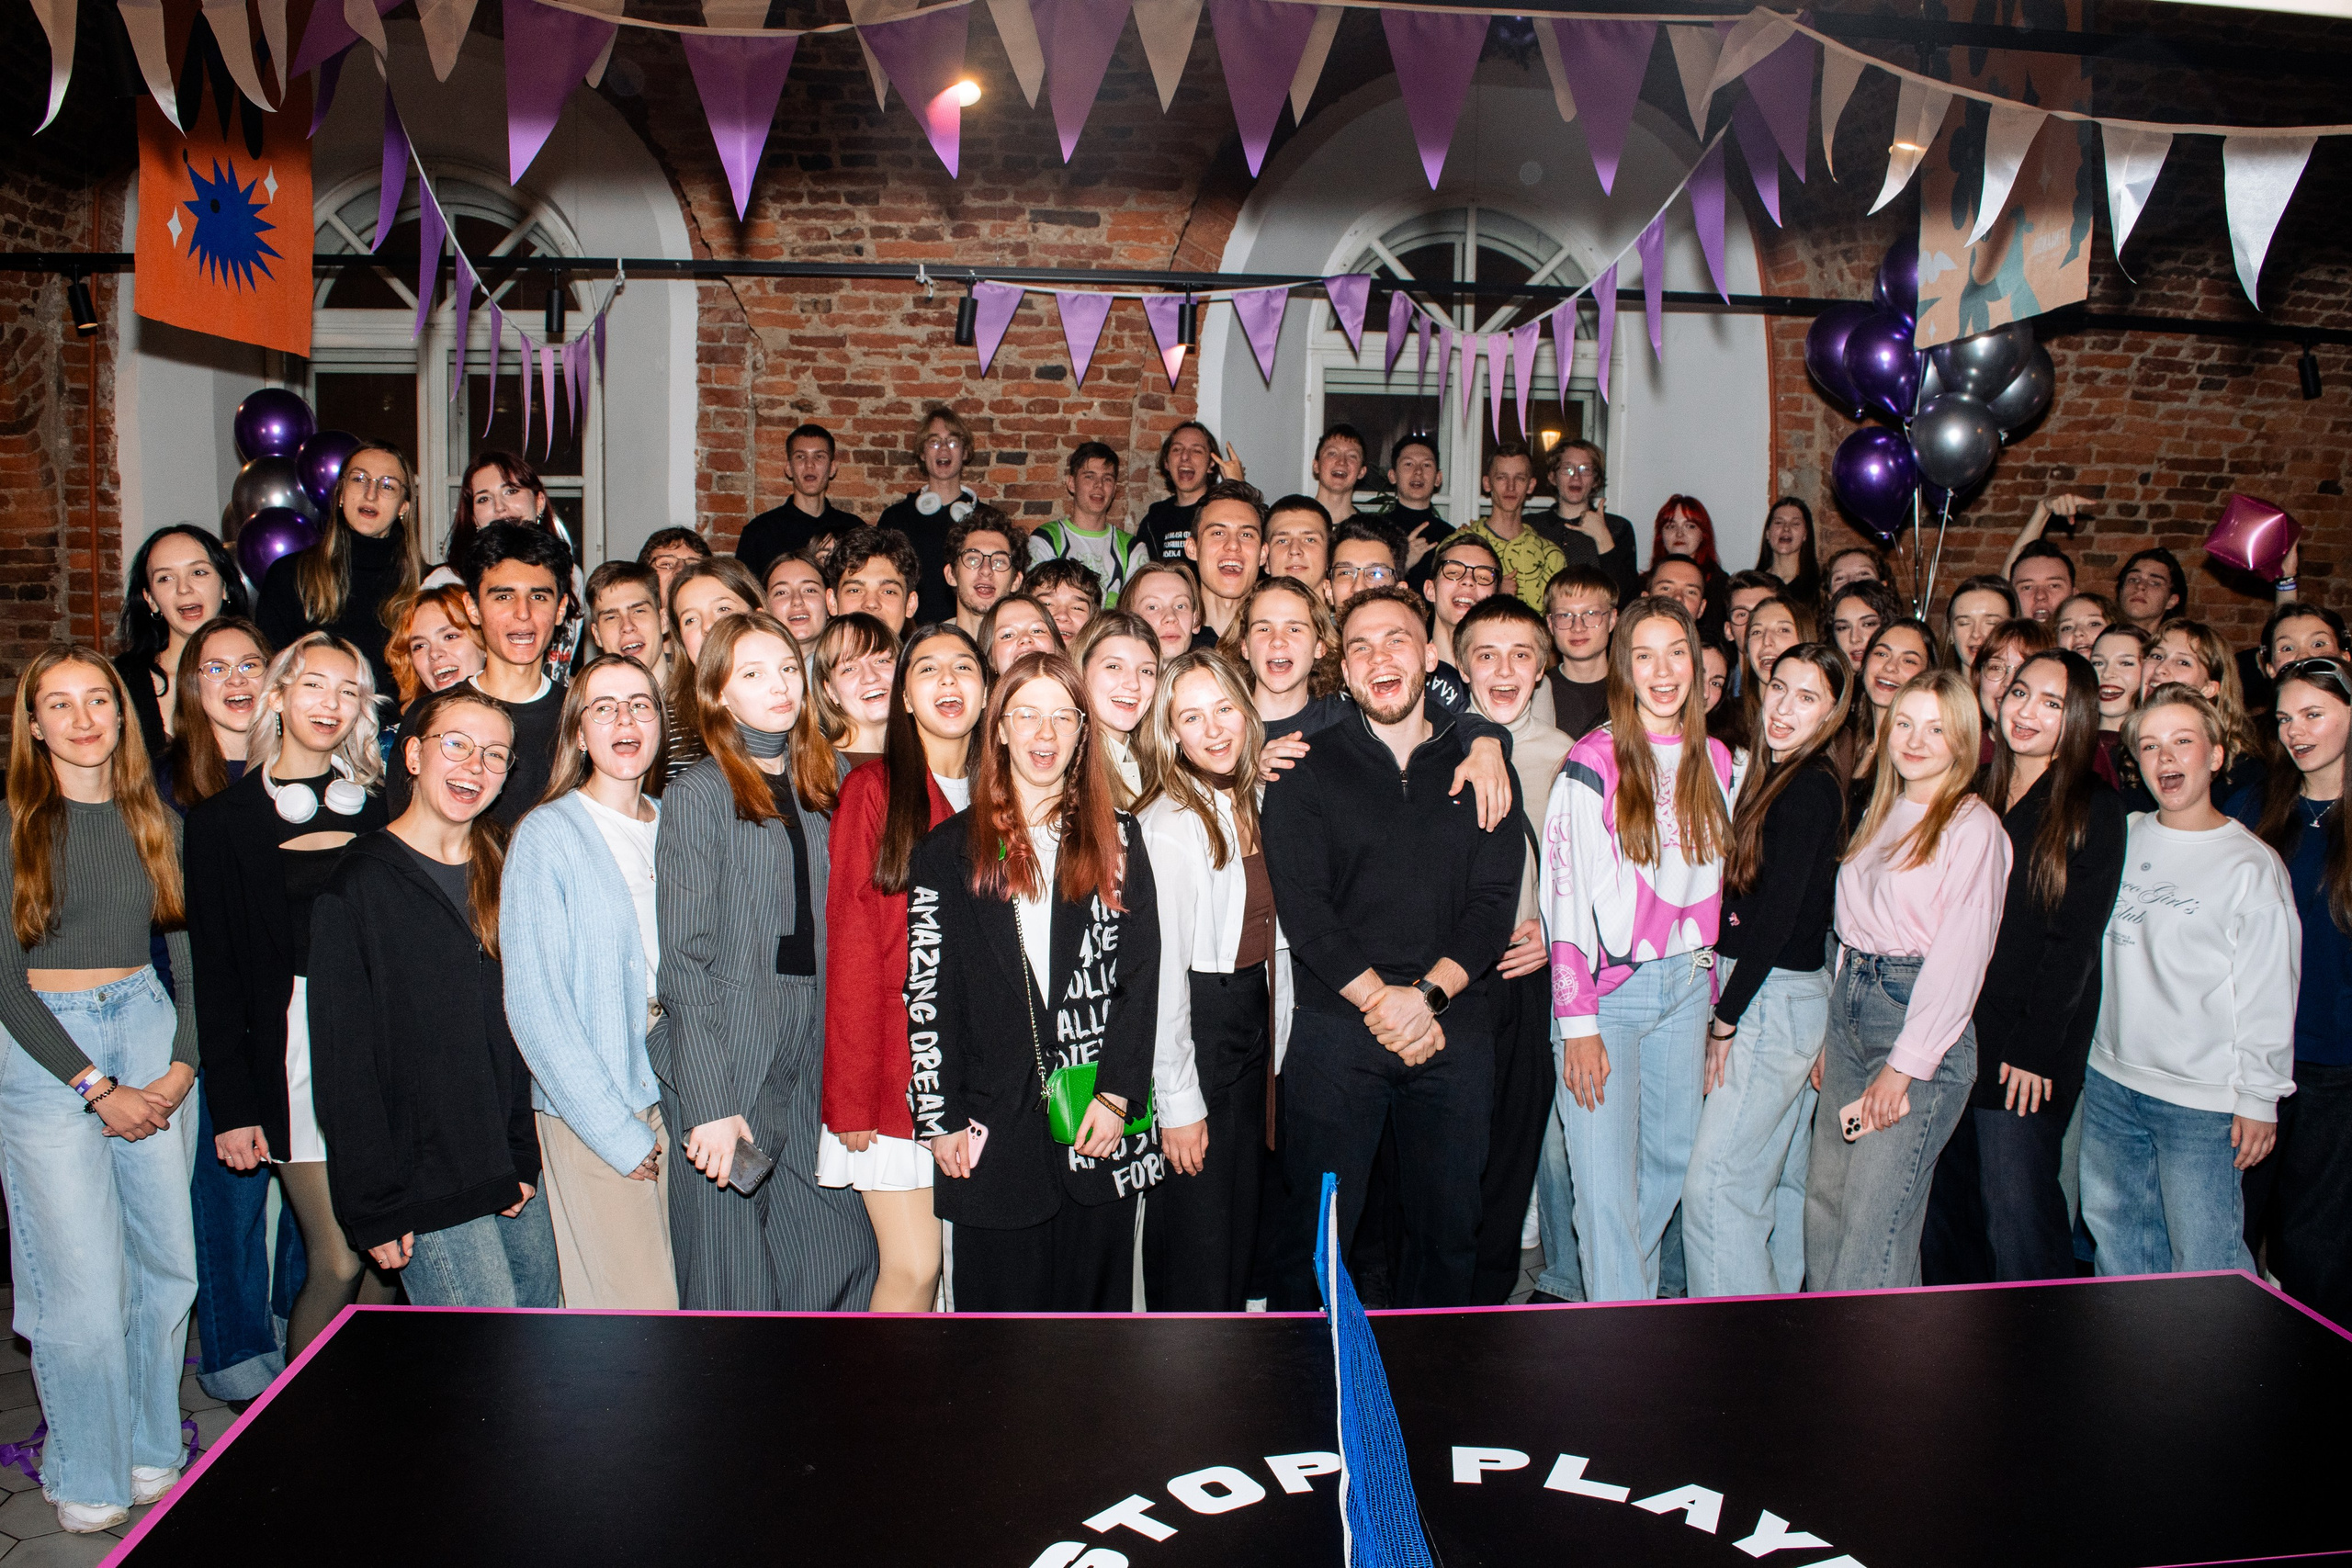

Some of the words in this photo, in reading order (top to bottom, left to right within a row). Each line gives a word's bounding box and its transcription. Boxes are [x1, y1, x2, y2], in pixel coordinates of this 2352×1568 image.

[2138, 881, 2199, 914] Girl's
[909, 886, 942, 1025] AMAZING
[910, 1031, 948, 1139] DREAM
[1451, 1446, 1868, 1568] PLAY
